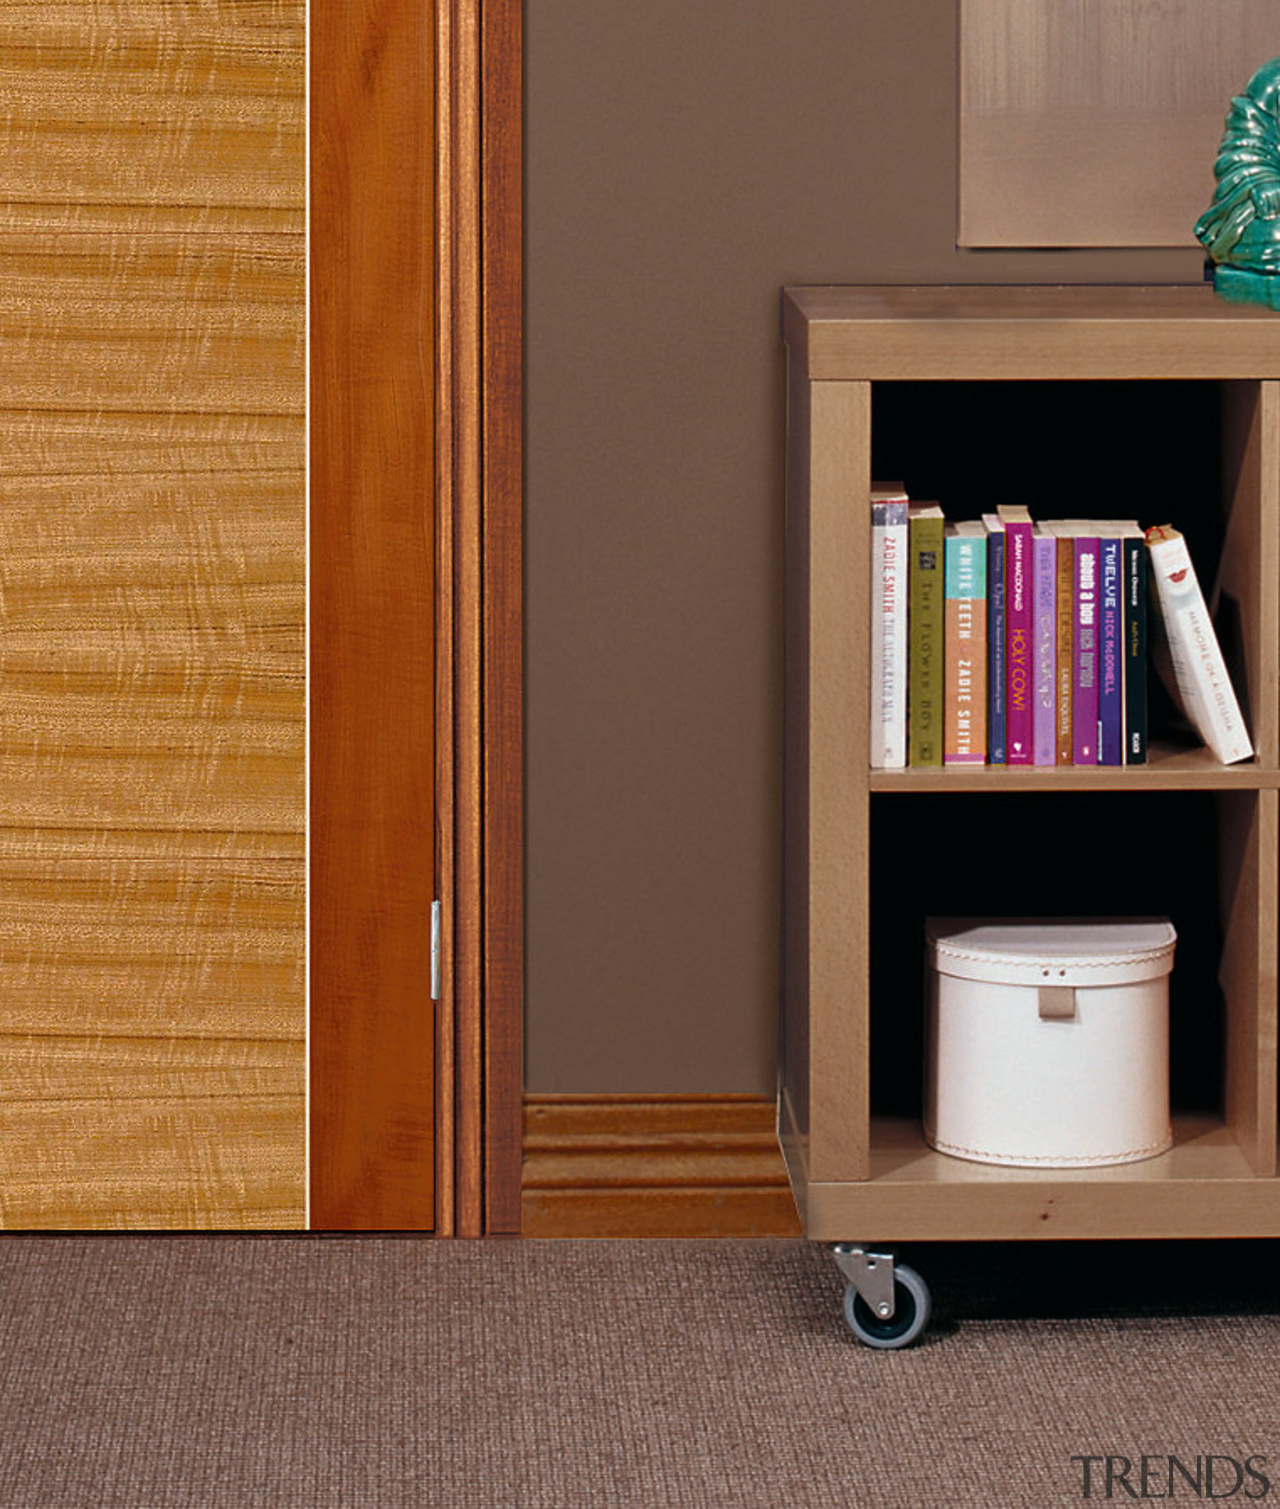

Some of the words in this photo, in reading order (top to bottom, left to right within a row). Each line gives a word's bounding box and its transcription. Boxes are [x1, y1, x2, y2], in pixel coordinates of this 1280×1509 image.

[883, 537, 896, 570] ZADIE
[1014, 534, 1023, 559] SARAH
[959, 545, 972, 589] WHITE
[1079, 553, 1094, 589] about
[1105, 545, 1115, 608] TWELVE
[882, 577, 894, 613] SMITH
[959, 597, 971, 639] TEETH
[1079, 603, 1094, 625] boy
[1105, 611, 1113, 636] NICK
[1011, 629, 1024, 664] HOLY
[958, 660, 971, 702] ZADIE
[1011, 669, 1024, 710] COW!
[958, 710, 970, 754] SMITH
